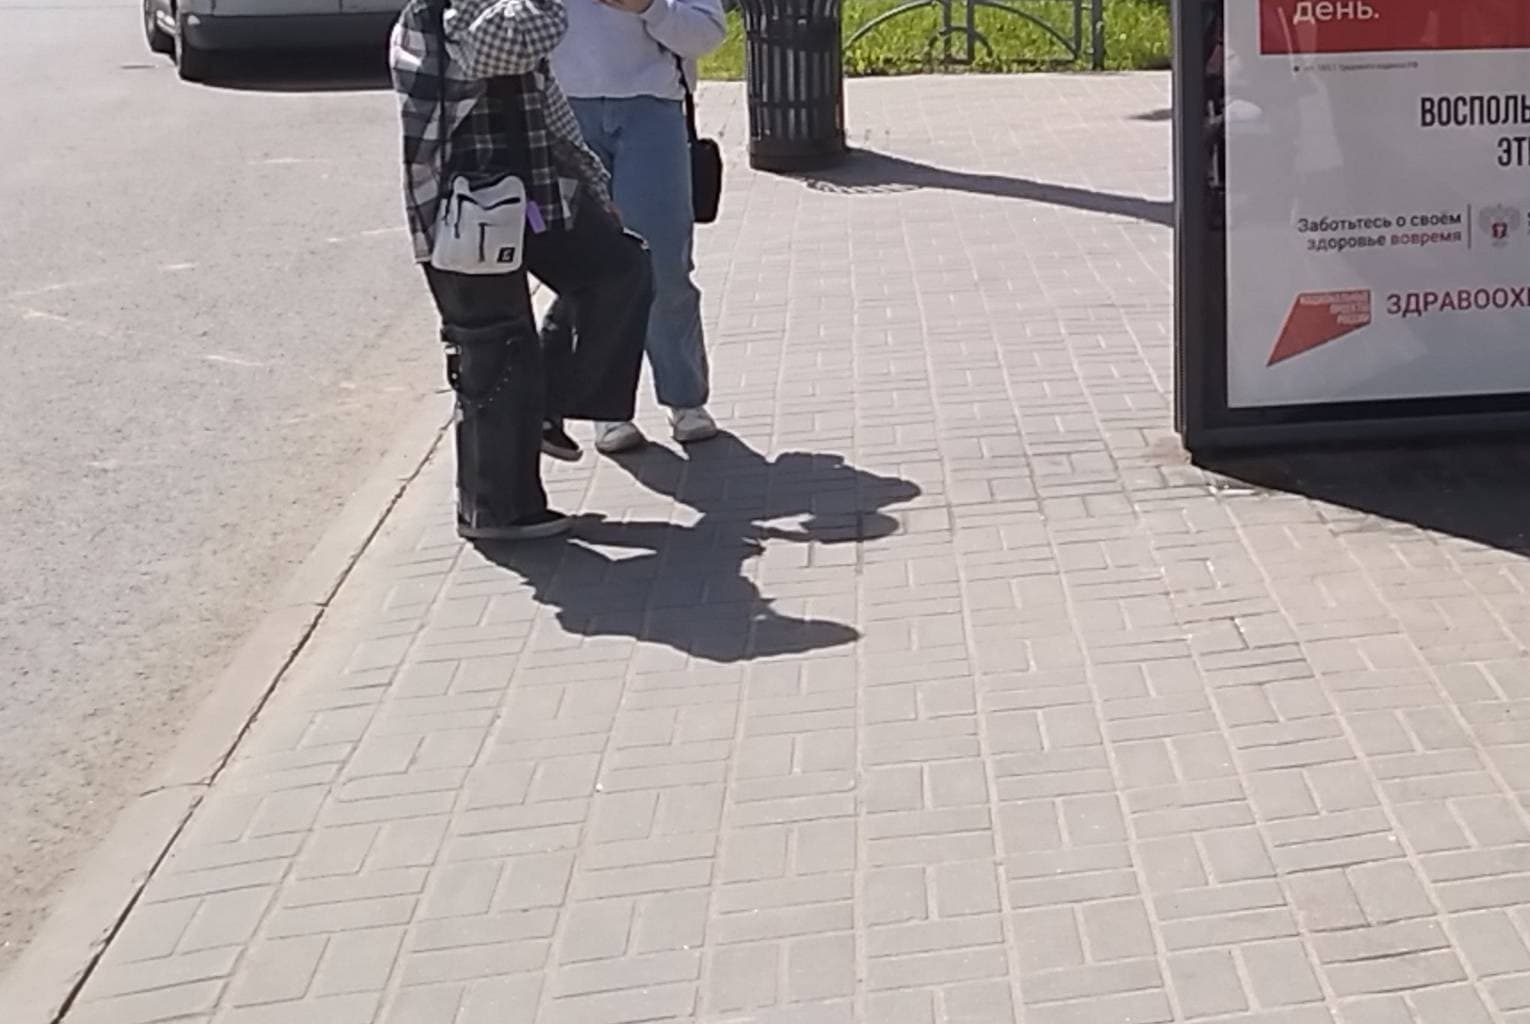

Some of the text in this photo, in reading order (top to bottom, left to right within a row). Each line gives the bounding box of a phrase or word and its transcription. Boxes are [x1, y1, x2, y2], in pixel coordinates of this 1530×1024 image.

[1298, 215, 1392, 233] Заботьтесь
[1396, 216, 1407, 228] о
[1307, 230, 1462, 252] здоровье вовремя
